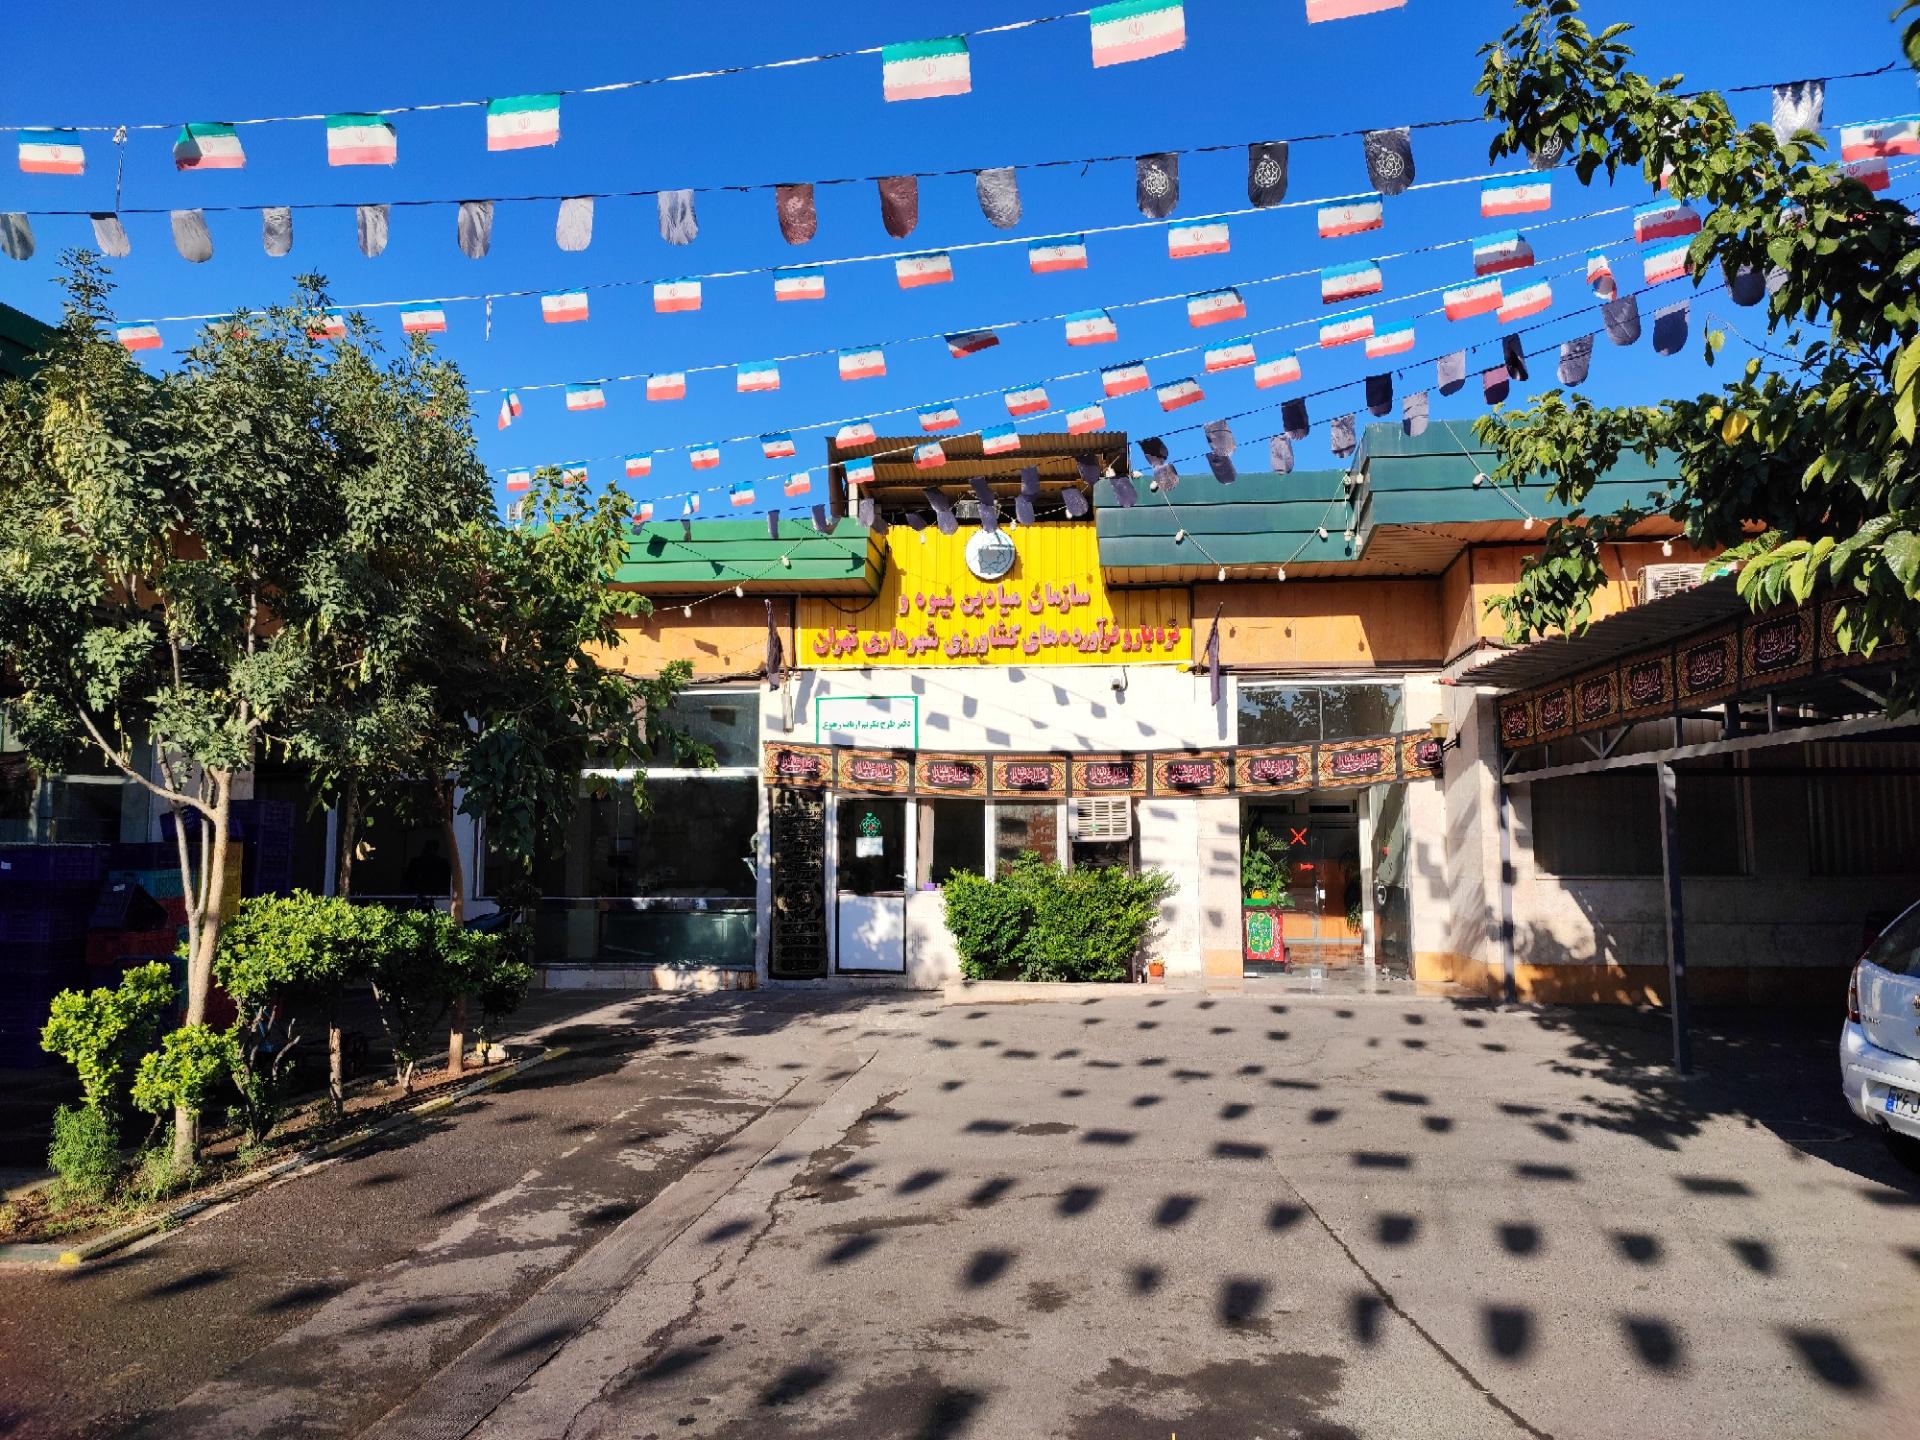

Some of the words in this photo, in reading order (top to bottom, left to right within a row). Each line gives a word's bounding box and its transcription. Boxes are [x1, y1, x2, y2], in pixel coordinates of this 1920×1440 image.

[897, 593, 909, 617] و
[915, 591, 954, 619] میوه
[960, 583, 1021, 619] میادین
[1027, 583, 1090, 615] سازمان
[813, 624, 859, 657] تهران
[862, 621, 938, 655] شهرداری
[944, 619, 1021, 657] کشاورزی
[1121, 629, 1132, 652] و
[1131, 624, 1154, 652] بار
[1156, 618, 1180, 651] تره
[880, 720, 895, 729] طرح
[897, 719, 911, 729] دفتر
